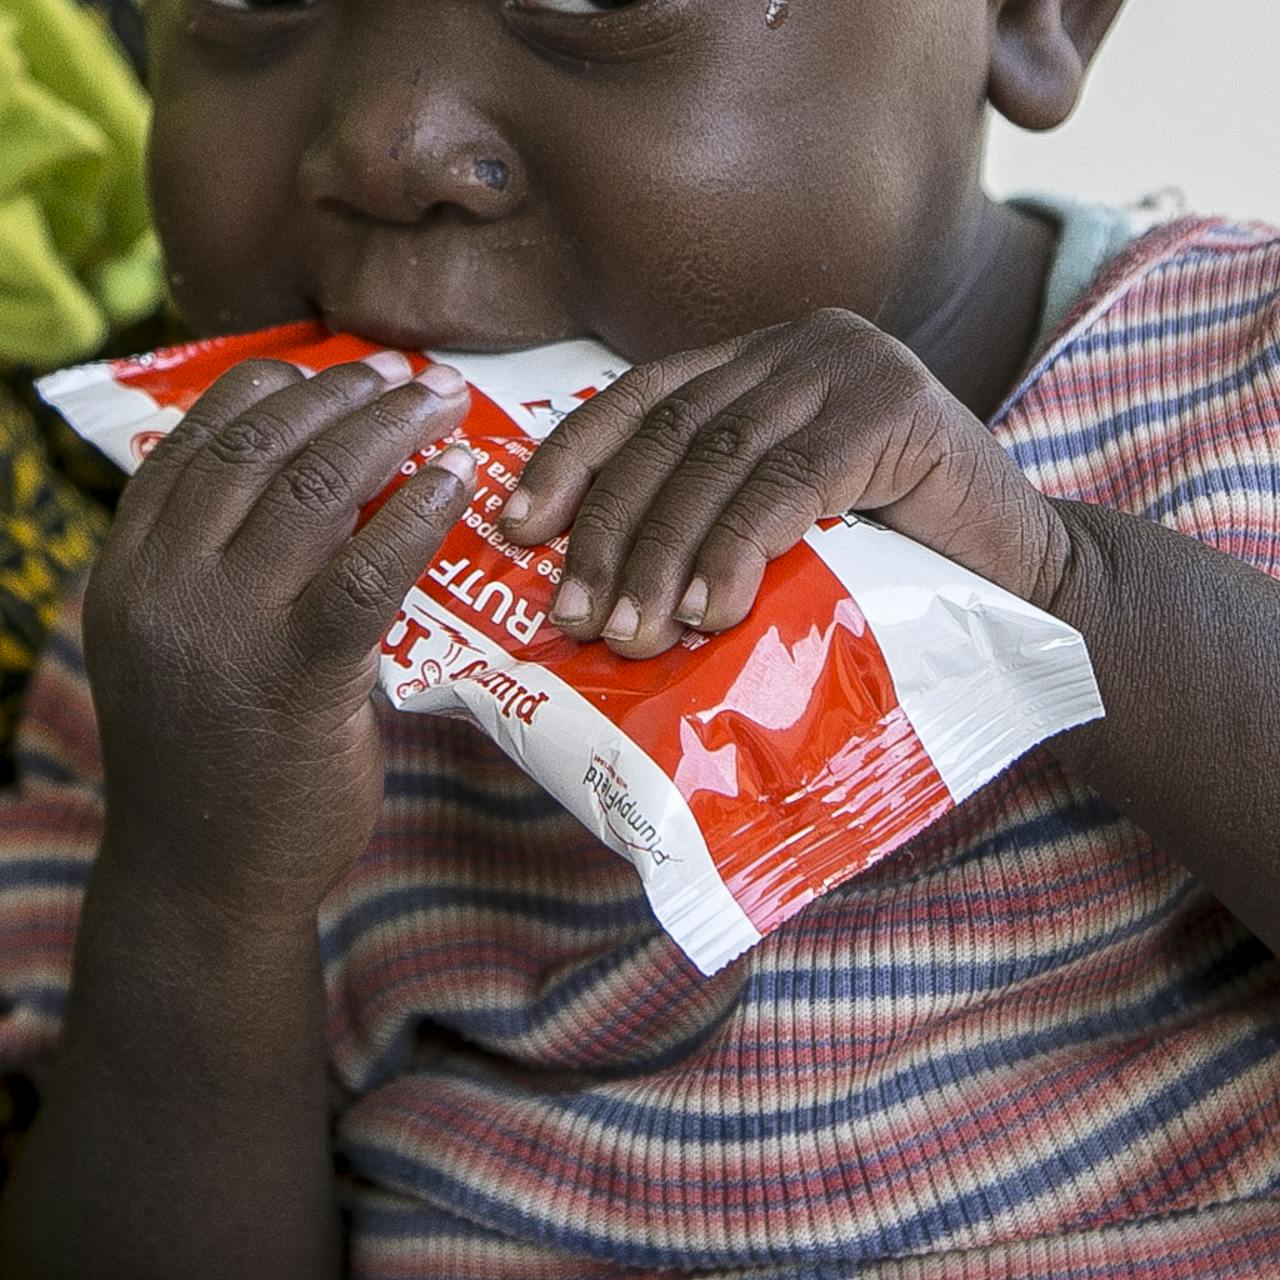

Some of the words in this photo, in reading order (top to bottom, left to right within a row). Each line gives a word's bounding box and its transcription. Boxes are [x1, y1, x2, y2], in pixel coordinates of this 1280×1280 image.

[504, 441, 534, 462] cute
[487, 462, 521, 491] ara
[537, 559, 562, 584] se
[427, 558, 546, 646] RUTF
[583, 766, 670, 866] PlumpyField
